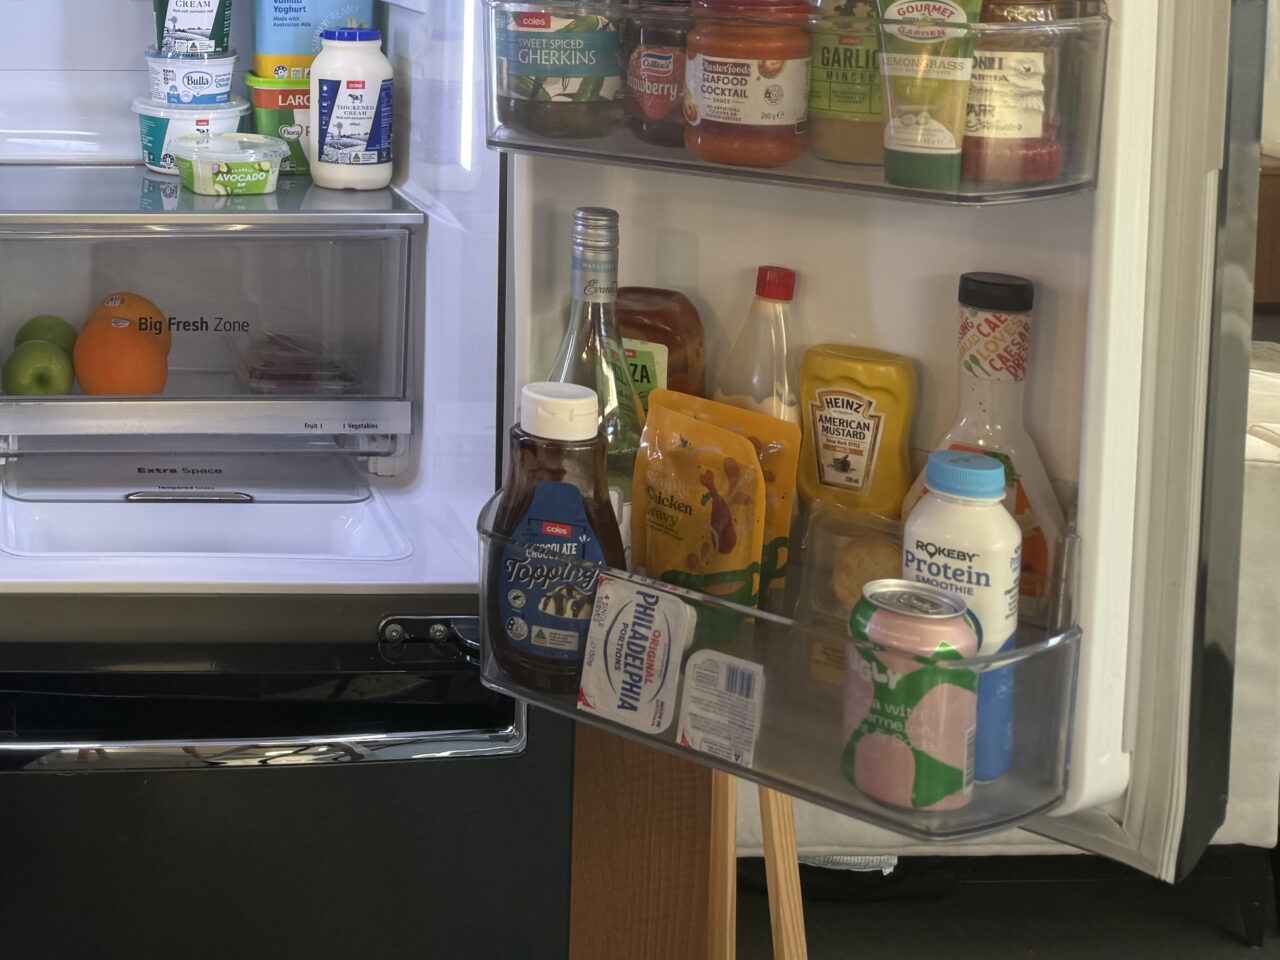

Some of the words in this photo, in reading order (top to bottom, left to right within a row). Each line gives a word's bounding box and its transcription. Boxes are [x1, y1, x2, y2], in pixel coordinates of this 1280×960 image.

[175, 0, 211, 8] CREAM
[273, 5, 307, 15] Yoghurt
[897, 3, 956, 19] GOURMET
[522, 17, 546, 26] coles
[897, 24, 947, 37] GARDEN
[519, 39, 547, 48] SWEET
[550, 39, 584, 49] SPICED
[519, 49, 597, 65] GHERKINS
[185, 76, 209, 87] Bulla
[701, 73, 748, 86] SEAFOOD
[826, 71, 876, 83] MINCED
[700, 85, 749, 99] COCKTAIL
[278, 95, 310, 106] LARG
[283, 128, 300, 136] Flora
[216, 172, 266, 183] AVOCADO
[138, 317, 163, 335] Big
[168, 317, 209, 332] Fresh
[214, 317, 250, 332] Zone
[976, 316, 1023, 361] LOVES
[988, 322, 1031, 372] CAESAR
[824, 397, 865, 414] HEINZ
[347, 422, 379, 430] Vegetables
[818, 414, 871, 432] AMERICAN
[821, 424, 866, 440] MUSTARD
[181, 467, 223, 475] Space
[546, 526, 567, 535] coles
[904, 549, 991, 588] Protein
[915, 574, 975, 596] SMOOTHIE
[614, 622, 630, 671] PORTIONS
[616, 589, 660, 713] PHILADELPHIA
[644, 629, 662, 685] ORIGINAL
